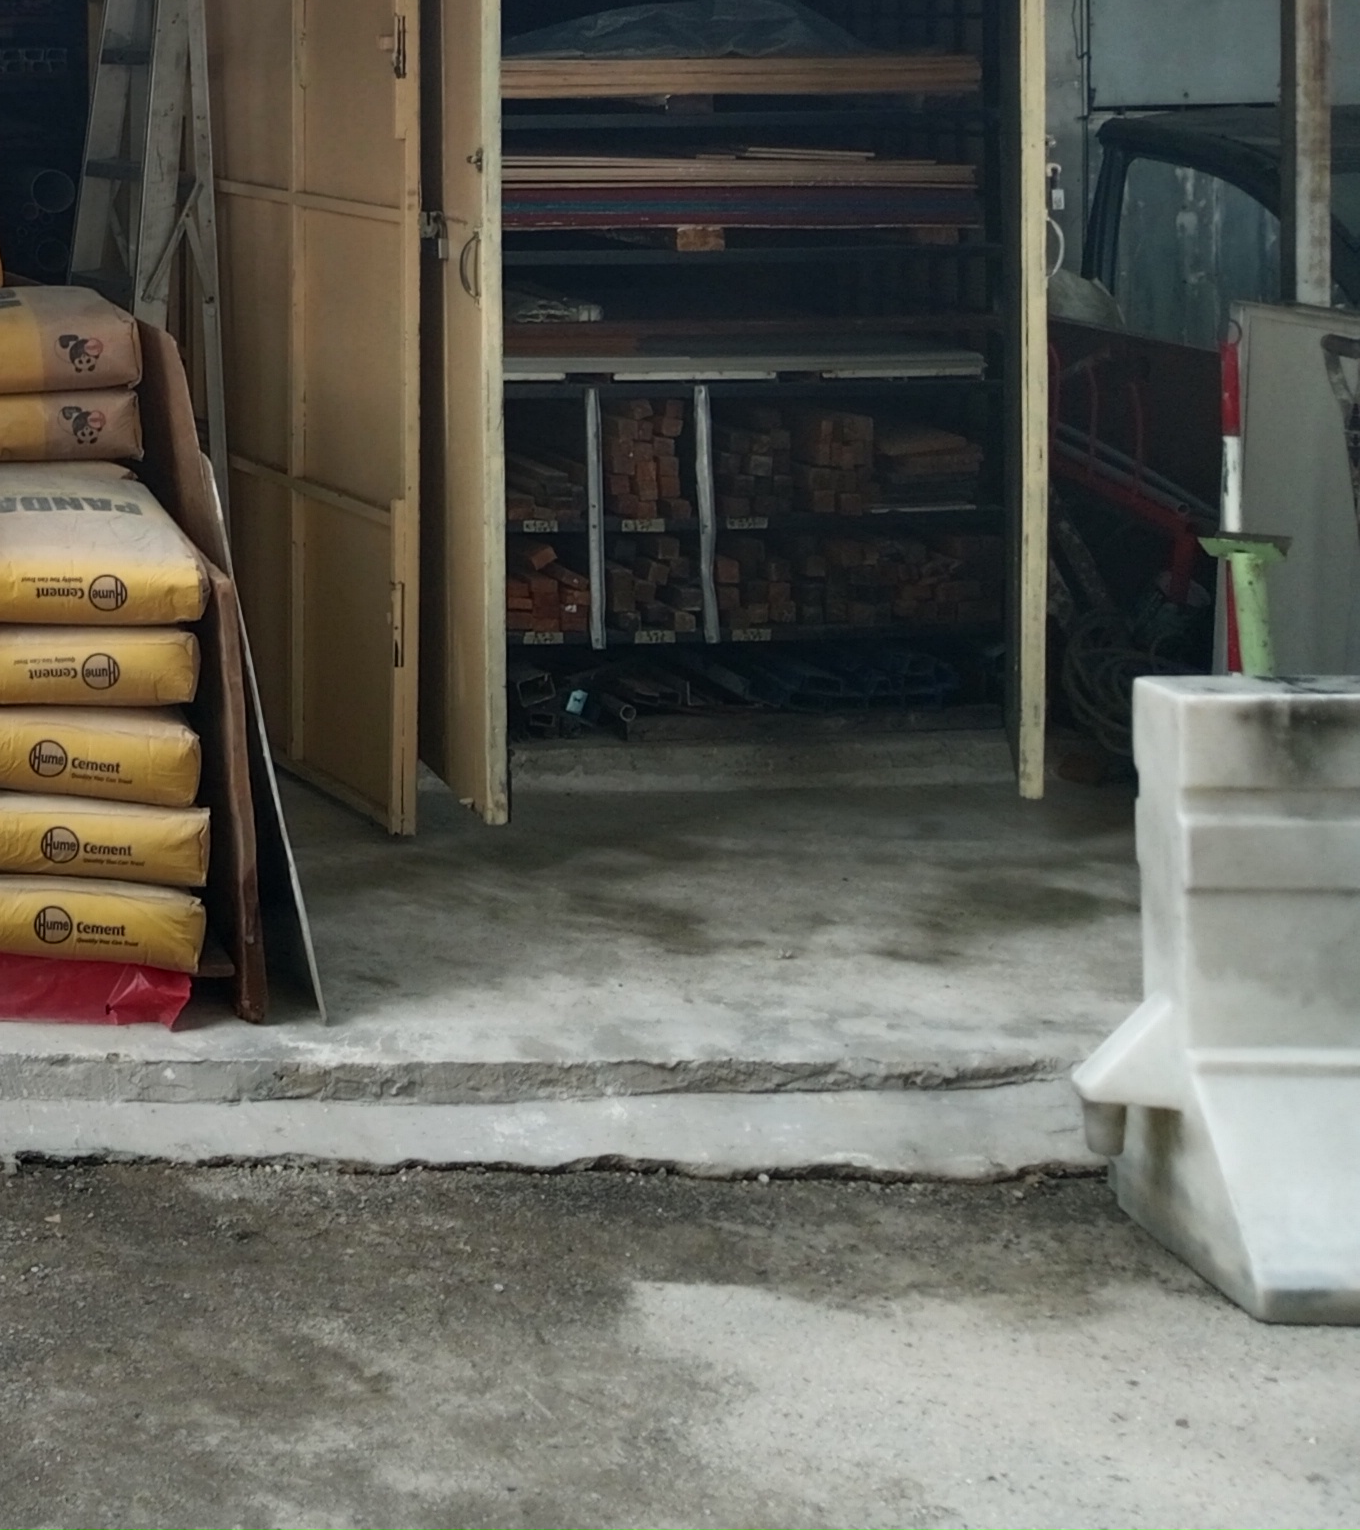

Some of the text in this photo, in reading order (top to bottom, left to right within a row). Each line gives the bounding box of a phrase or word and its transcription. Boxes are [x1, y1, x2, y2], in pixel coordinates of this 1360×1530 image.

[36, 575, 126, 610] Hume Cement
[29, 654, 119, 689] Hume Cement
[31, 741, 120, 776] Hume Cement
[42, 827, 132, 862] Hume Cement
[35, 907, 125, 943] Hume Cement
